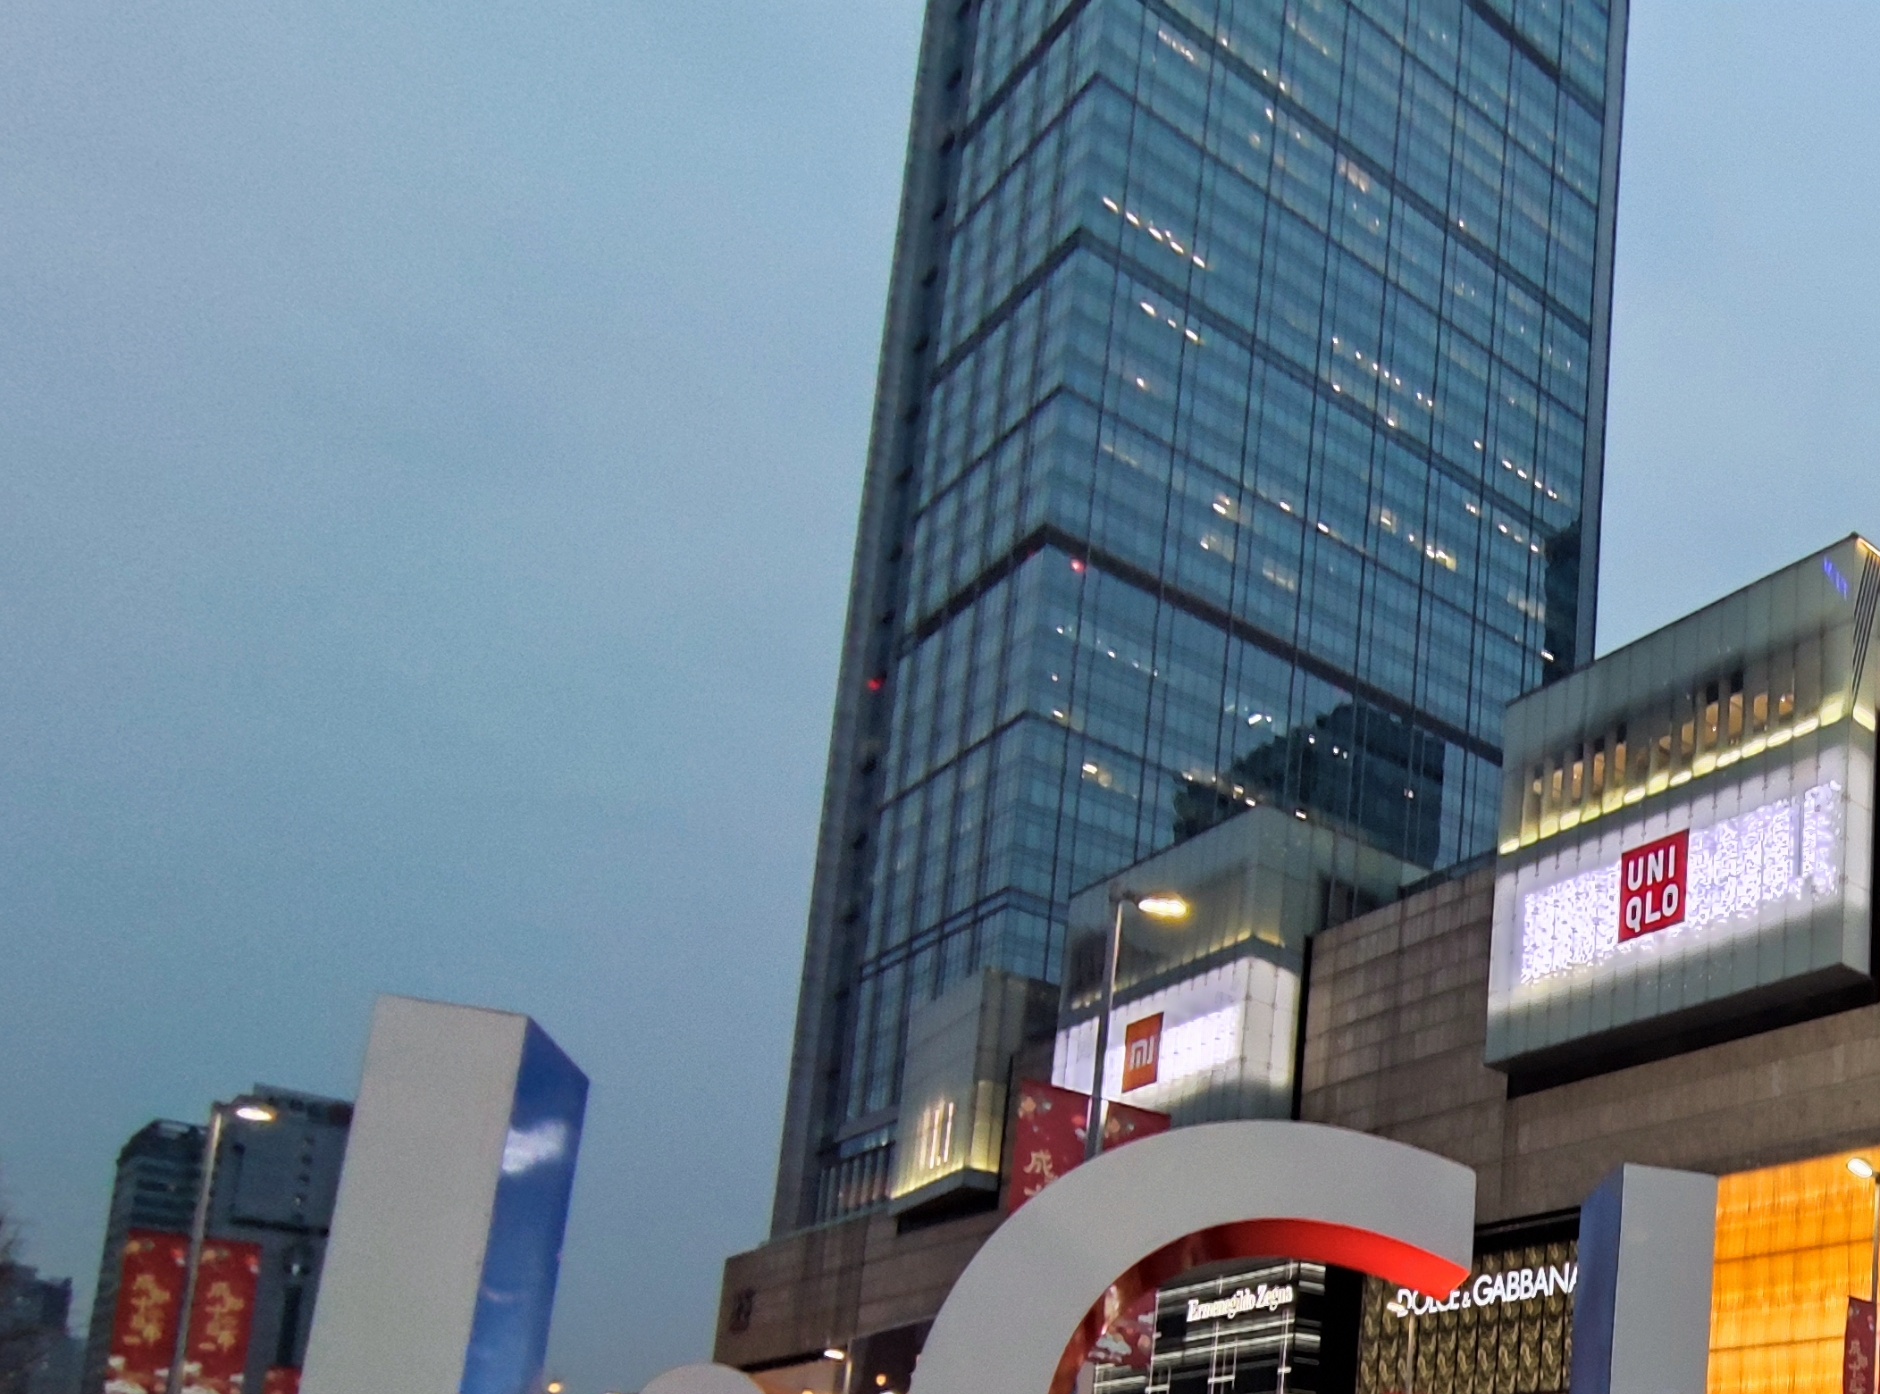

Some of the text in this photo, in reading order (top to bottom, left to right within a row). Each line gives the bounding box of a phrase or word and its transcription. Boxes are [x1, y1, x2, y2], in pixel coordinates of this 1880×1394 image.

[1628, 845, 1676, 891] UNI
[1626, 883, 1679, 932] QLO
[1256, 1283, 1294, 1312] Zegna
